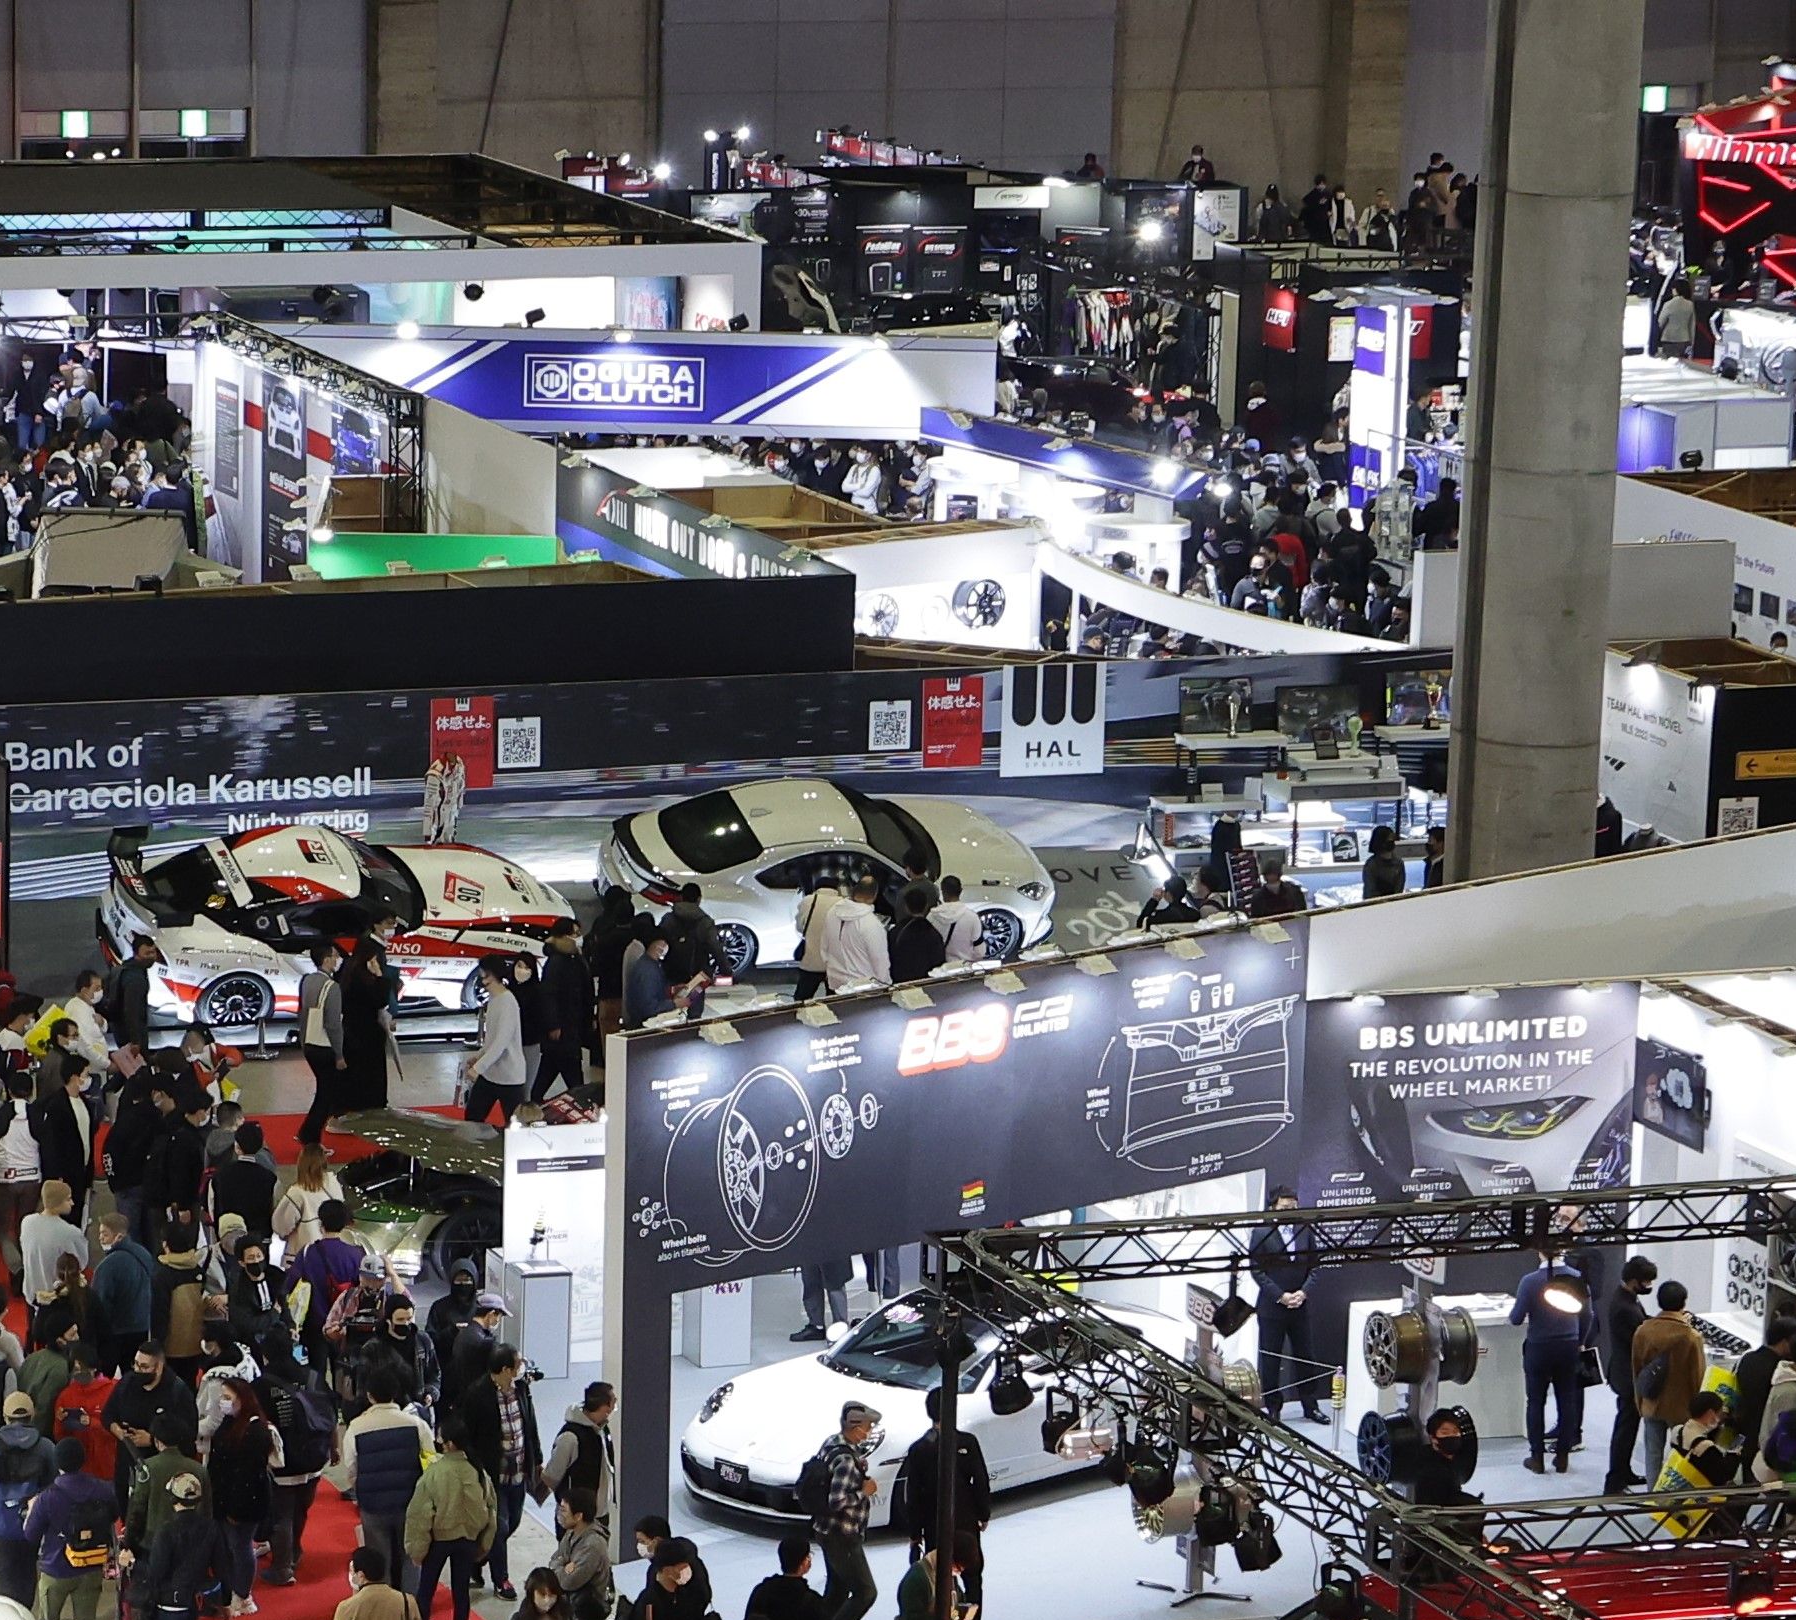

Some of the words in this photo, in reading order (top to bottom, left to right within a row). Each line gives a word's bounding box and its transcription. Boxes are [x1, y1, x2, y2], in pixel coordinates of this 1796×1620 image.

[571, 361, 695, 384] OGURA
[571, 383, 695, 405] CLUTCH
[670, 519, 696, 561] OUT
[926, 694, 983, 711] 体感せよ。
[1606, 696, 1627, 714] TEAM
[1627, 706, 1643, 721] HAL
[435, 714, 493, 732] 体感せよ。
[4, 741, 97, 774] Bank
[107, 737, 143, 767] of
[1024, 739, 1082, 759] HAL
[7, 777, 197, 814] Caracciola
[208, 766, 372, 806] Karussell
[1048, 863, 1137, 885] OVE
[385, 942, 423, 956] ENSO
[485, 934, 530, 949] FALKEN
[1012, 1015, 1070, 1040] UNLIMITED
[1358, 1025, 1416, 1051] BBS
[1424, 1015, 1589, 1047] UNLIMITED
[896, 1002, 1010, 1078] BBS
[1349, 1061, 1388, 1079] THE
[1394, 1053, 1523, 1076] REVOLUTION
[1529, 1051, 1550, 1069] IN
[1554, 1048, 1593, 1067] THE
[1086, 1086, 1111, 1100] Wheel
[1388, 1081, 1460, 1100] WHEEL
[1465, 1075, 1552, 1097] MARKET!
[1086, 1098, 1110, 1111] widths
[1206, 1151, 1222, 1163] sizes
[1321, 1186, 1373, 1198] UNLIMITED
[1401, 1181, 1452, 1193] UNLIMITED
[1481, 1176, 1532, 1188] UNLIMITED
[1569, 1181, 1601, 1192] VALUE
[1316, 1195, 1377, 1208] DIMENSIONS
[661, 1237, 688, 1251] Wheel
[688, 1232, 708, 1246] bolts
[656, 1251, 673, 1264] also
[681, 1243, 712, 1258] titanium
